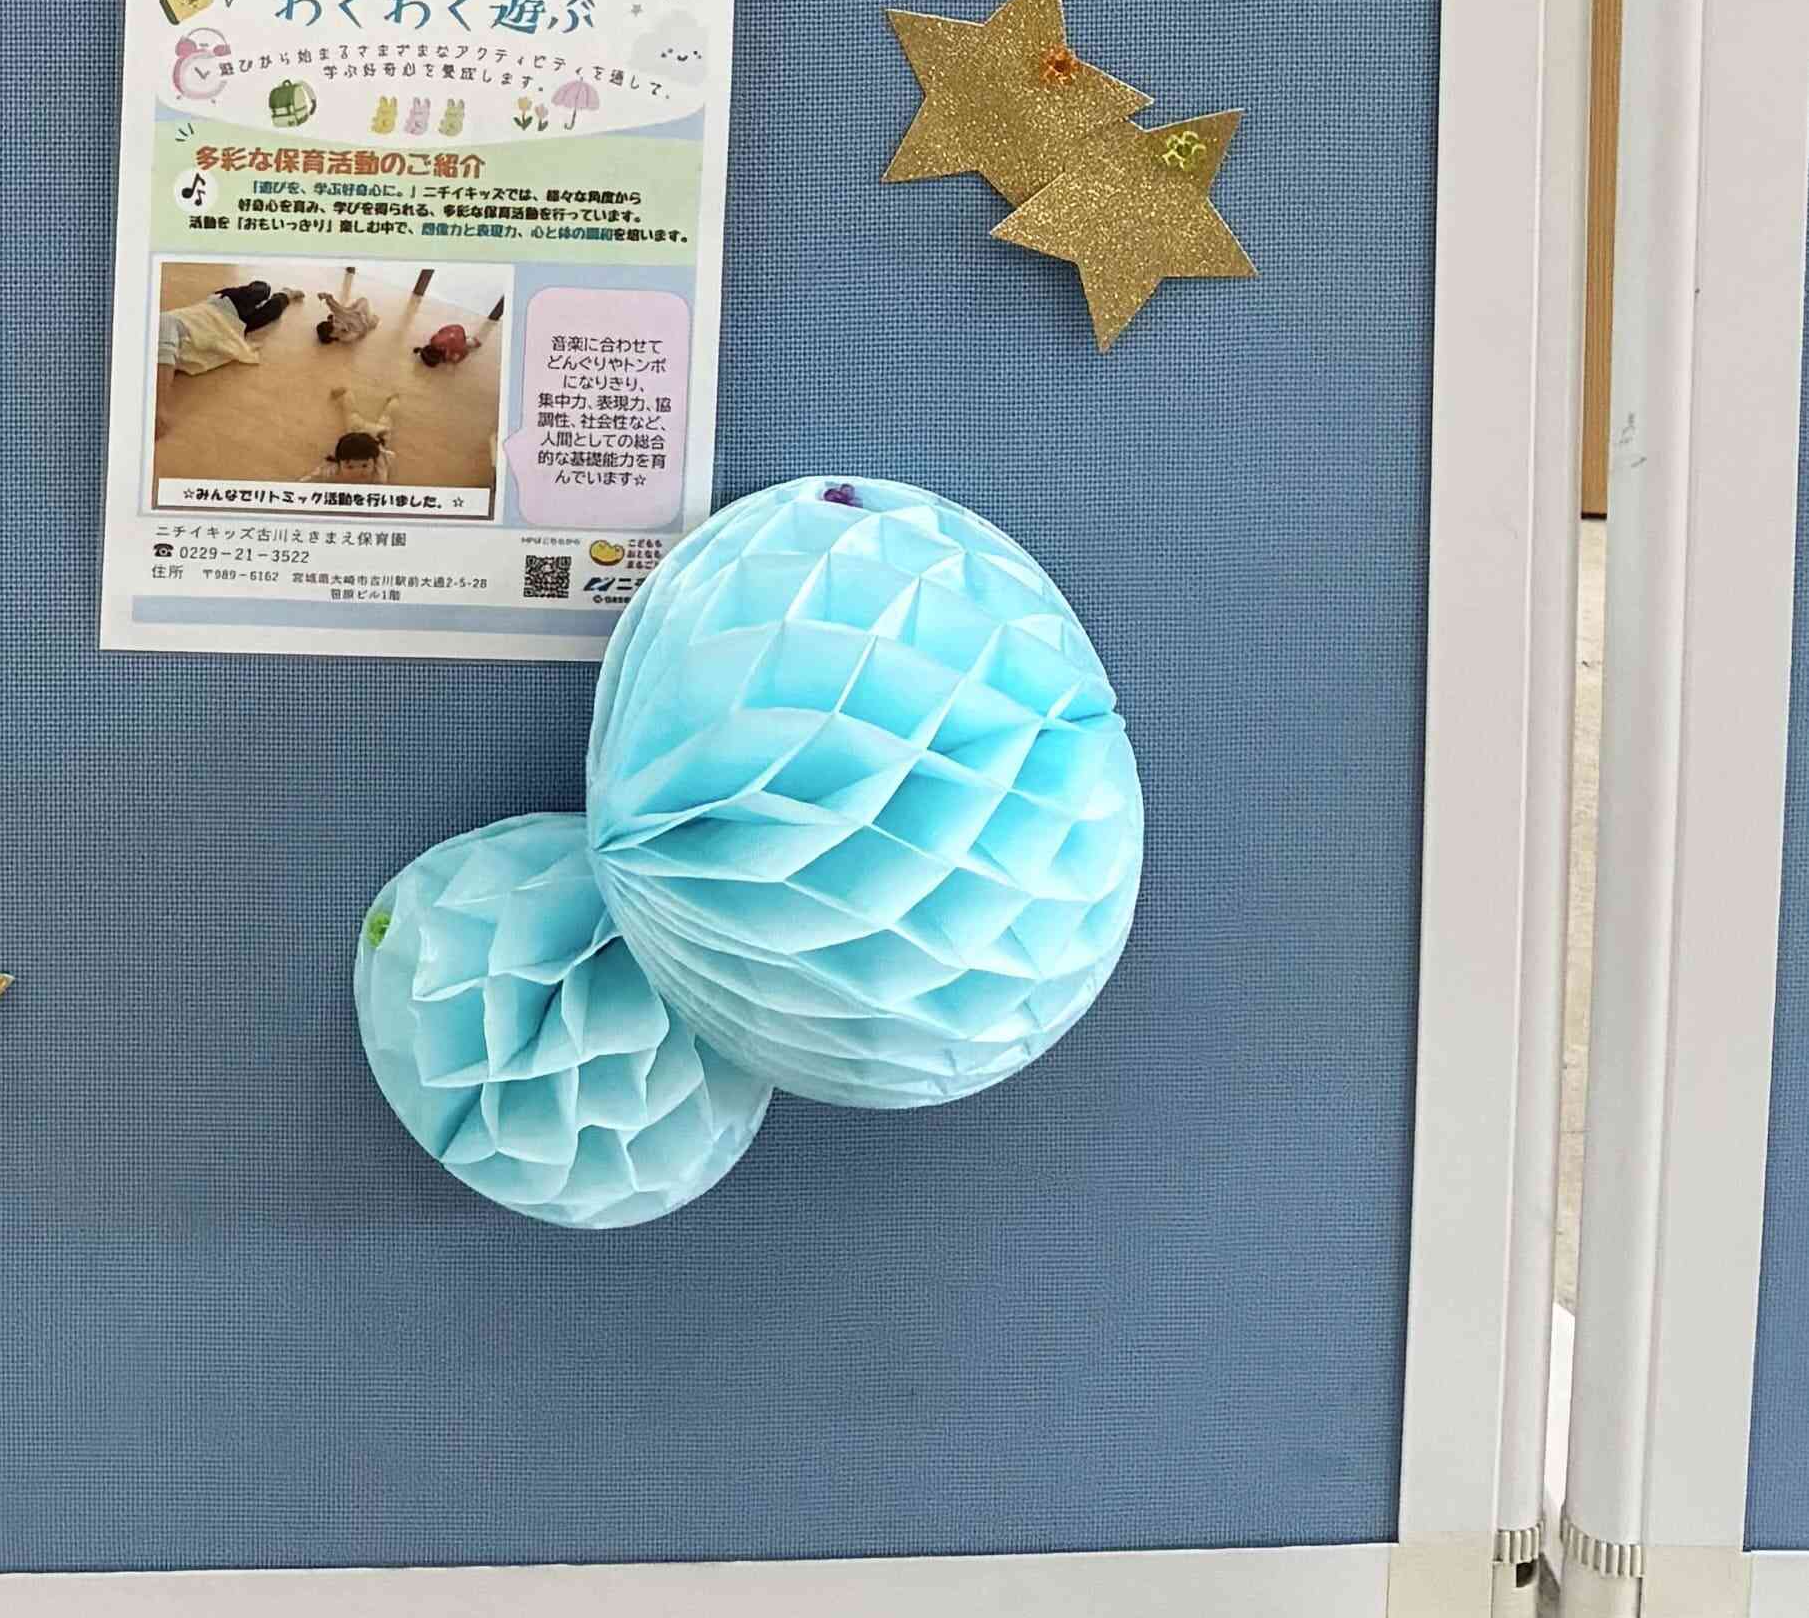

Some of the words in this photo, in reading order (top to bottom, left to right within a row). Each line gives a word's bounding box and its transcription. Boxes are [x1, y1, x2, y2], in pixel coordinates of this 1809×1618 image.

[195, 145, 486, 180] 多彩な保育活動のご紹介
[551, 334, 664, 355] 音楽に合わせて
[563, 374, 645, 393] になりきり、
[537, 391, 672, 414] 集中力、表現力、協
[537, 410, 666, 433] 調性、社会性など、
[539, 430, 666, 453] 人間としての総合
[537, 448, 667, 472] 的な基礎能力を育
[155, 525, 407, 547] ニチイキッズ古川えきまえ保育園
